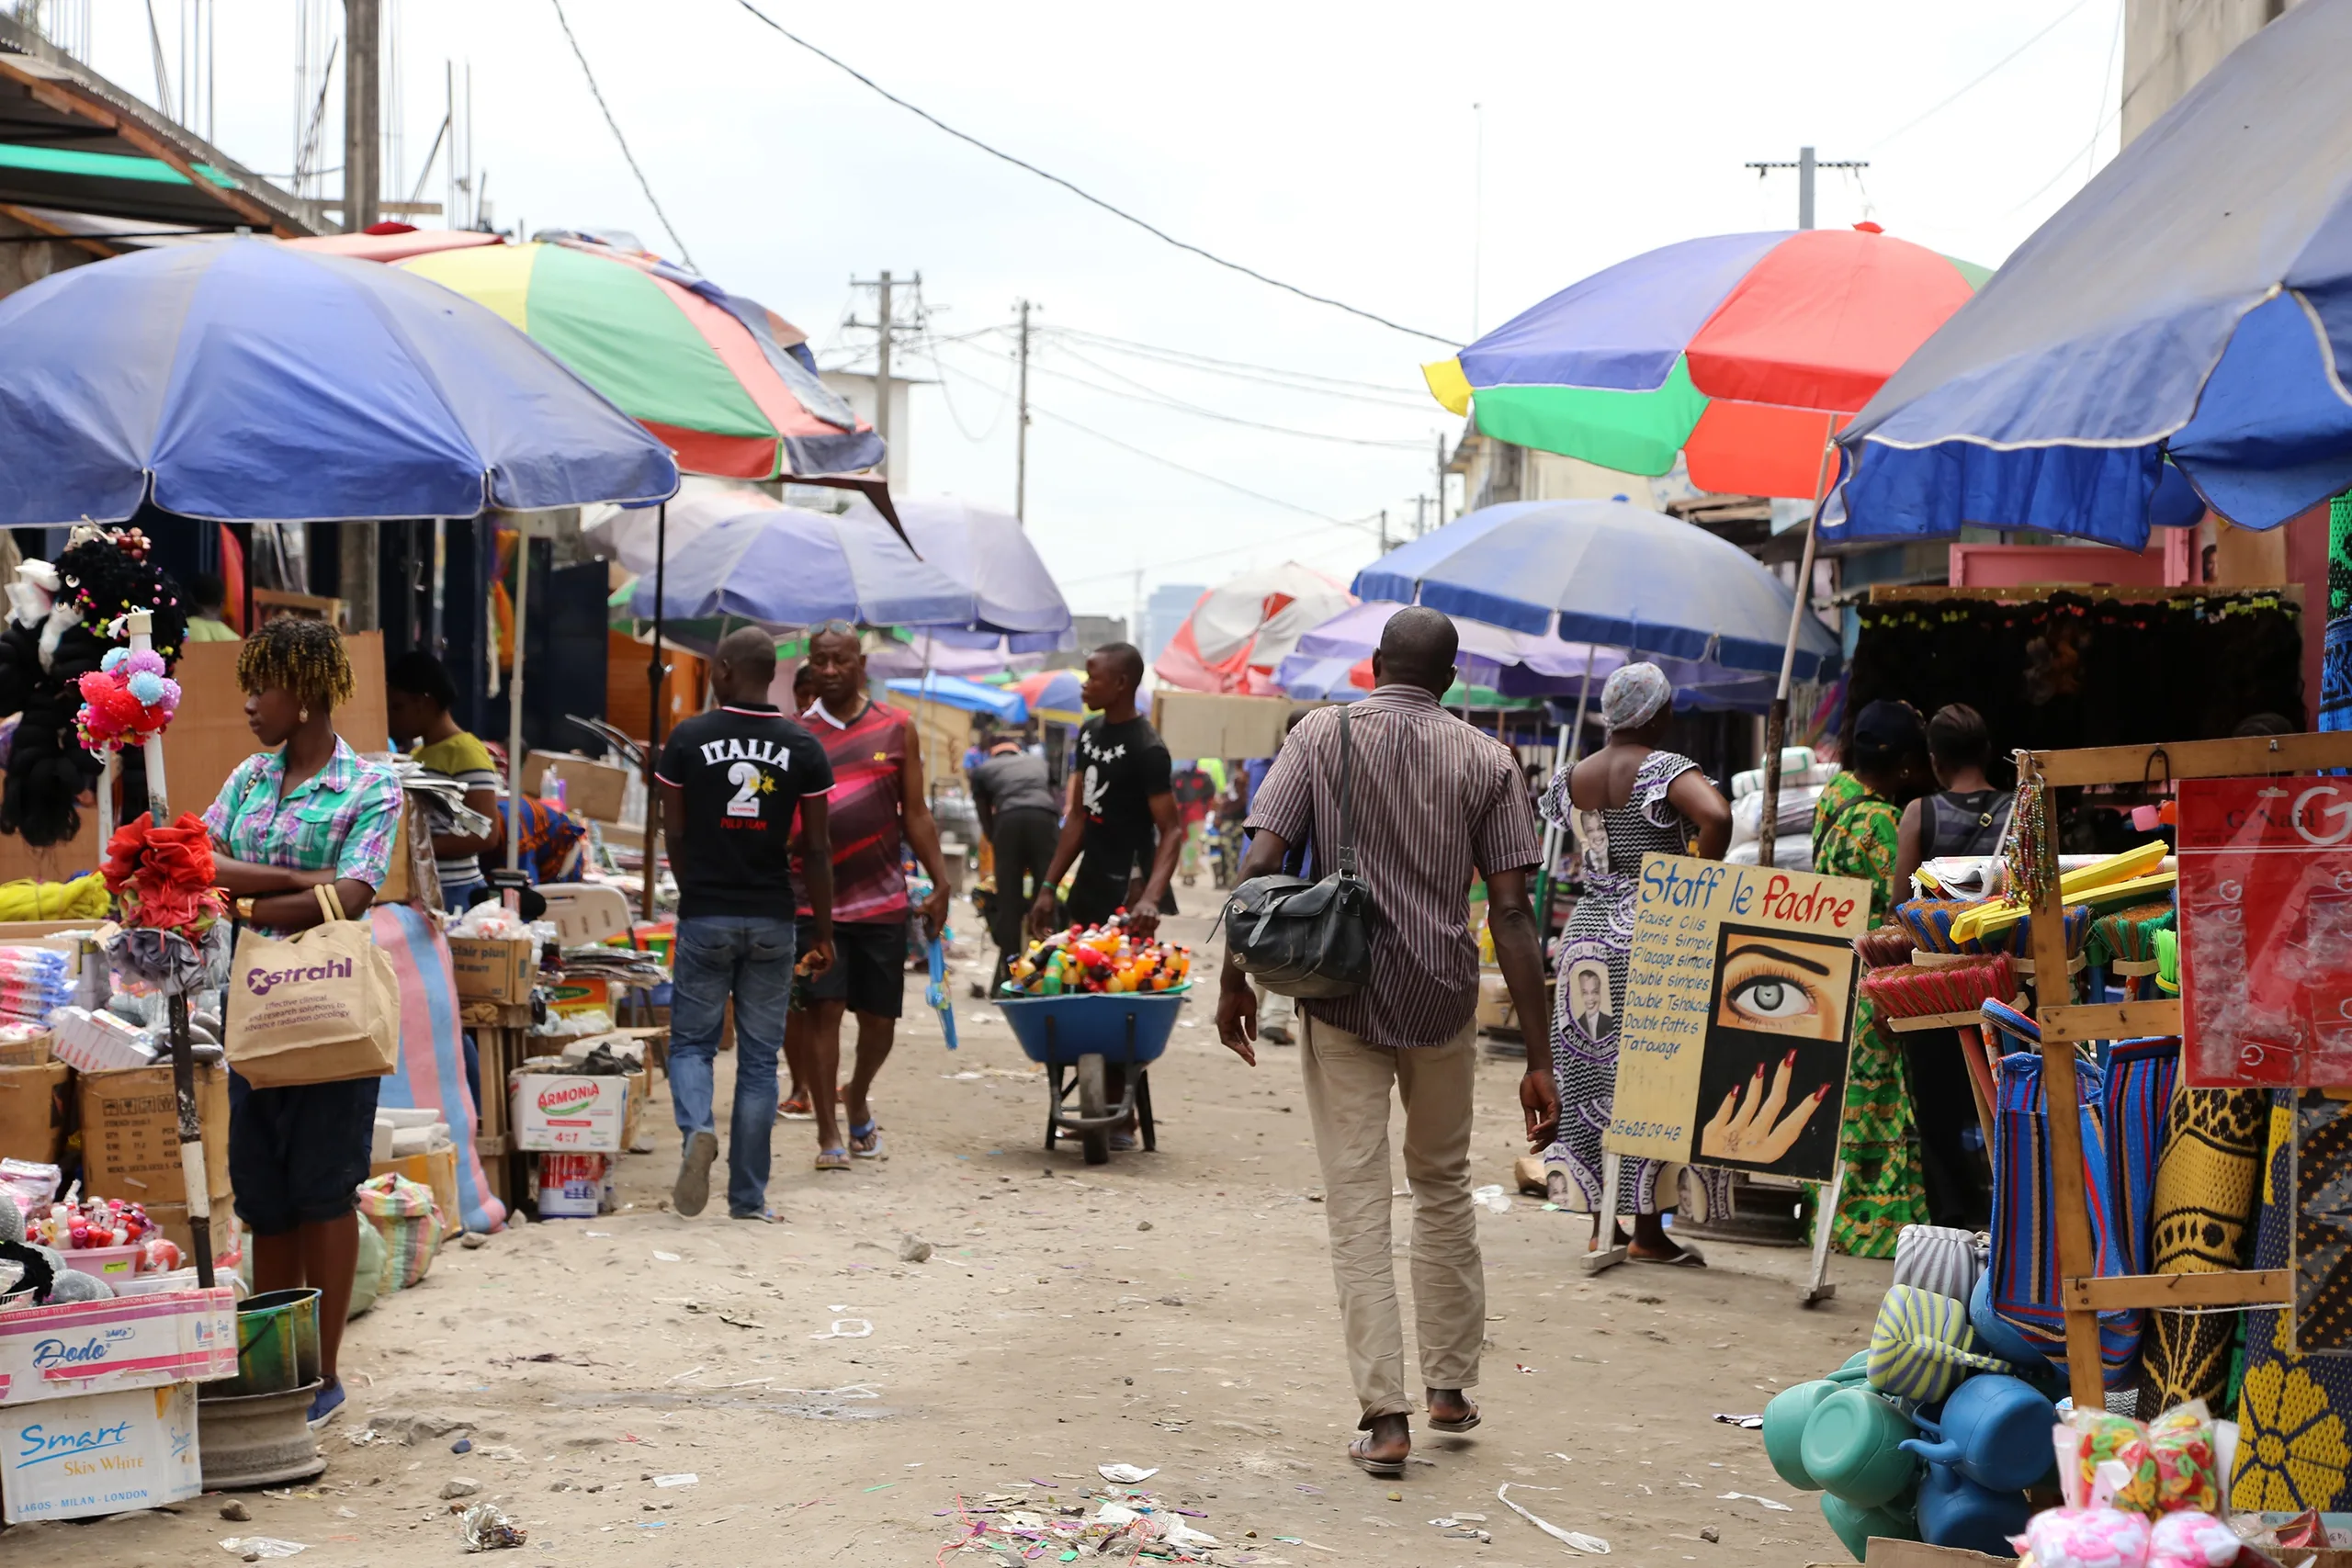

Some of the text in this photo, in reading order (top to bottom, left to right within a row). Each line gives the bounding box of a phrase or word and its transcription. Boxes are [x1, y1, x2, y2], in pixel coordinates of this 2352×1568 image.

[699, 738, 791, 772] ITALIA
[727, 761, 761, 818] 2
[1642, 860, 1856, 928] Staff le Padre
[1634, 928, 1713, 953] Vernis Simple
[1634, 946, 1675, 969] Placage
[1628, 968, 1710, 991] Double simples
[1626, 990, 1663, 1009] Double
[264, 1008, 297, 1021] research
[277, 1012, 312, 1026] radiation
[313, 1010, 350, 1021] oncology
[1624, 1013, 1699, 1034] Double Pattes
[1623, 1034, 1681, 1060] Tatouage
[537, 1082, 600, 1109] ARMONIA
[1585, 1179, 1601, 1205] 2016
[32, 1338, 107, 1369] Dodo
[20, 1421, 134, 1456] Smart
[61, 1495, 95, 1507] MILAN
[105, 1489, 148, 1503] LONDON
